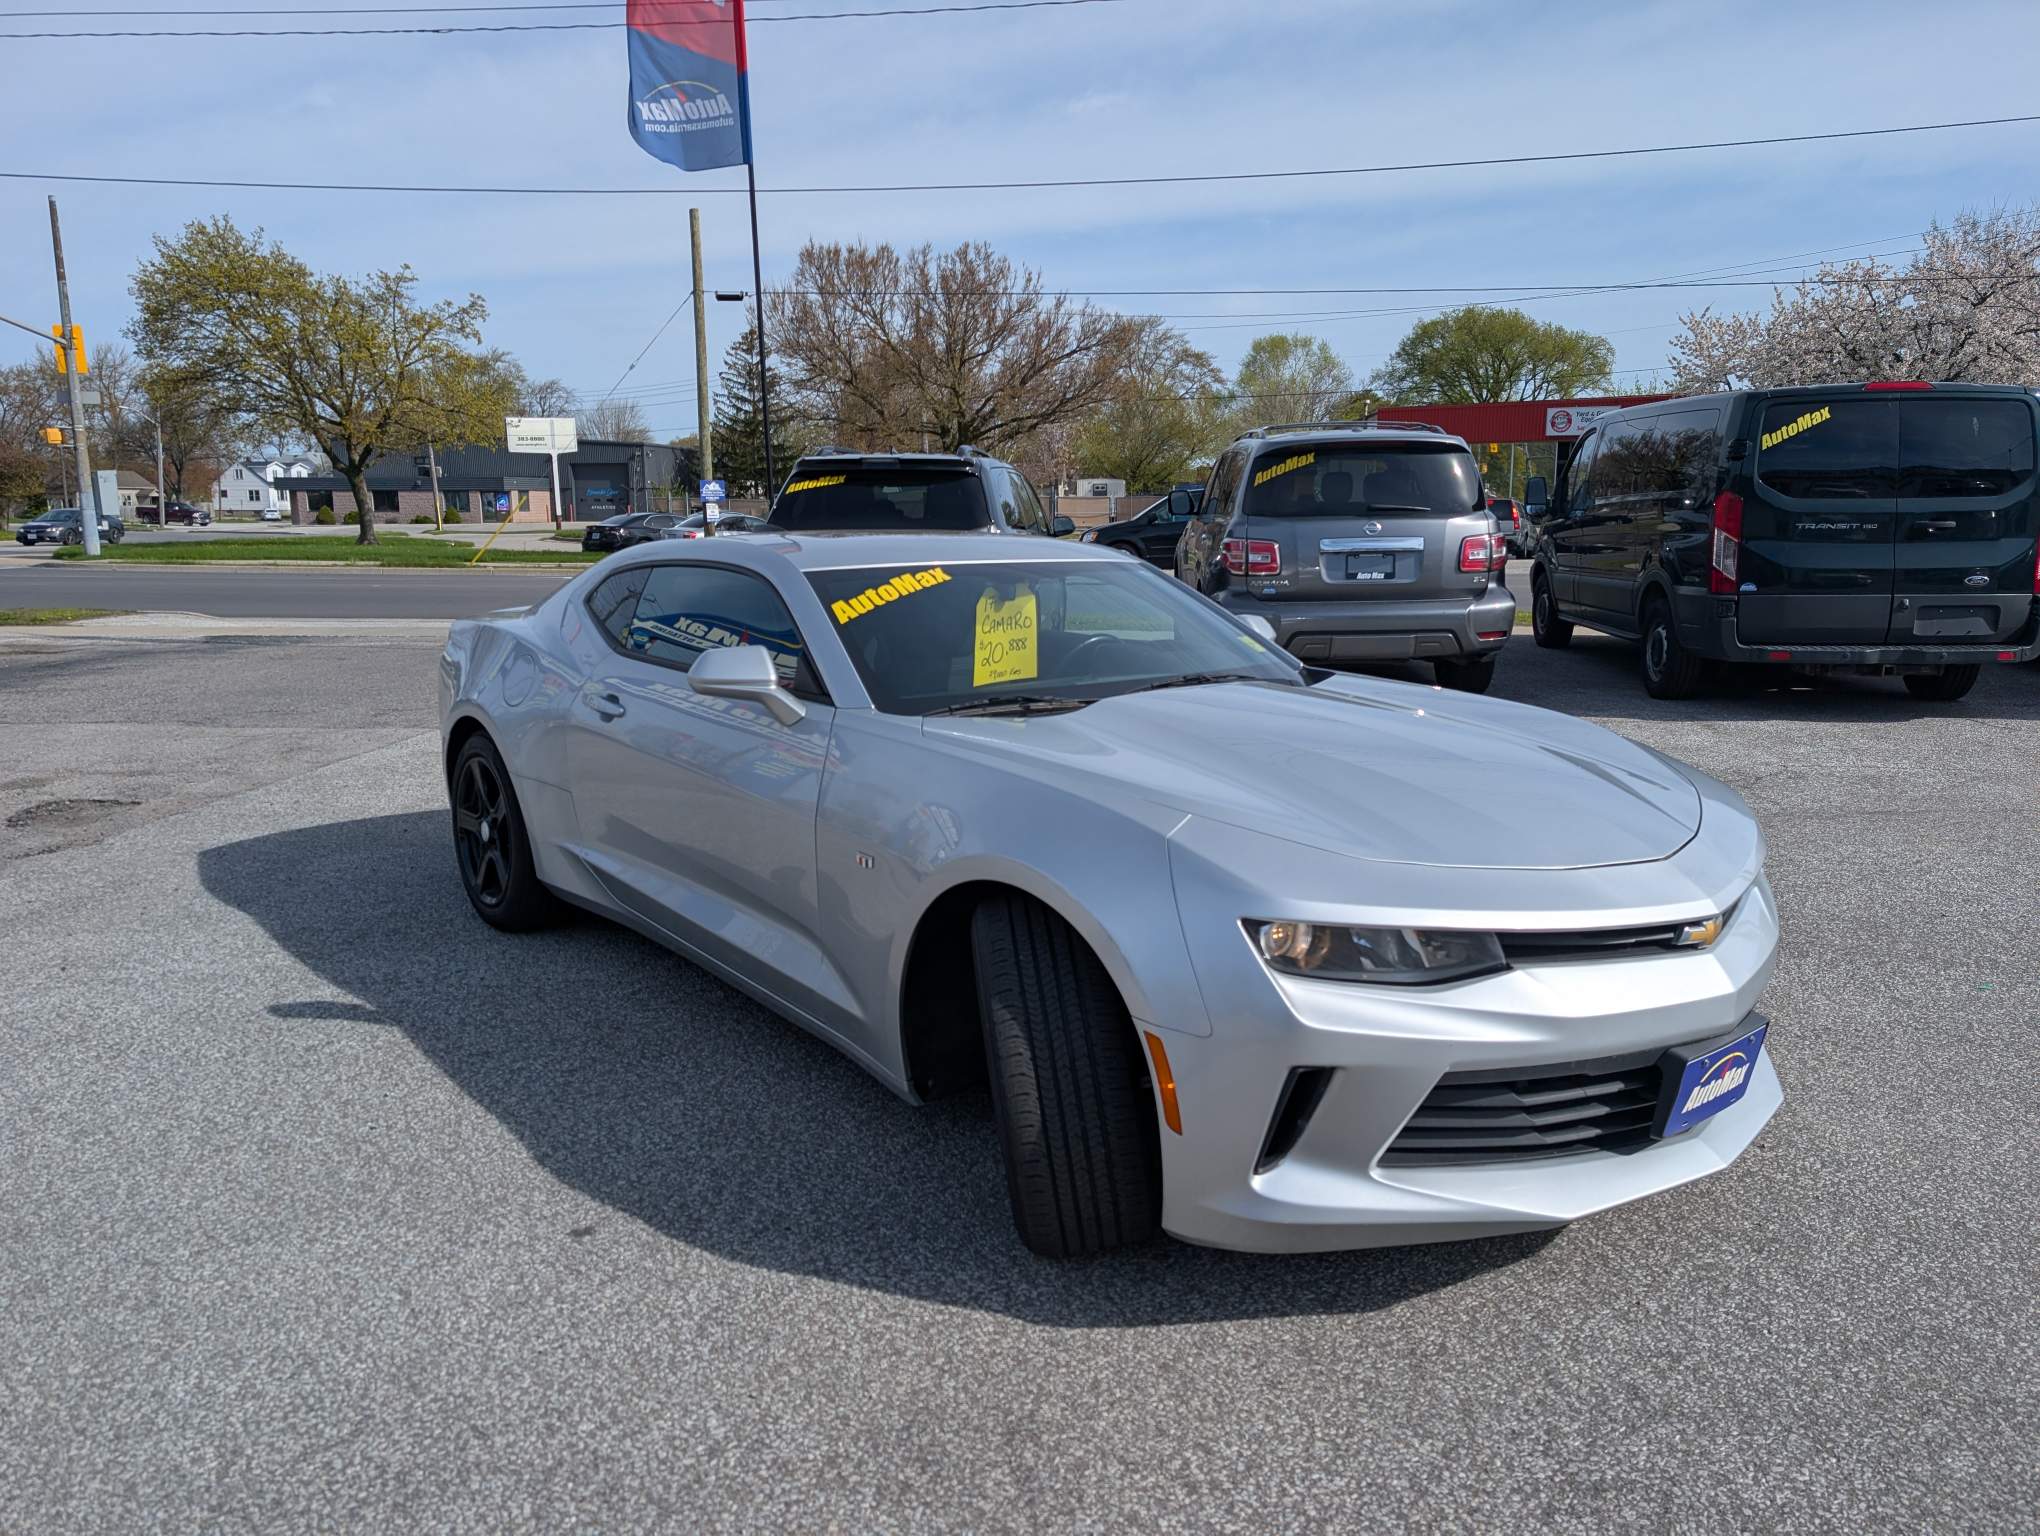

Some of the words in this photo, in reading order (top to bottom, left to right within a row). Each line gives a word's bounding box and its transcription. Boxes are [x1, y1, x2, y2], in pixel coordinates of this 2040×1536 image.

[1760, 405, 1832, 452] AutoMax
[785, 474, 848, 496] AutoMax
[1253, 451, 1316, 488] AutoMax
[1356, 571, 1372, 580] Auto
[1372, 571, 1385, 579] Max
[831, 566, 953, 625] AutoMax
[982, 611, 1033, 635] CAMARO
[1681, 1062, 1751, 1114] AutoMax
